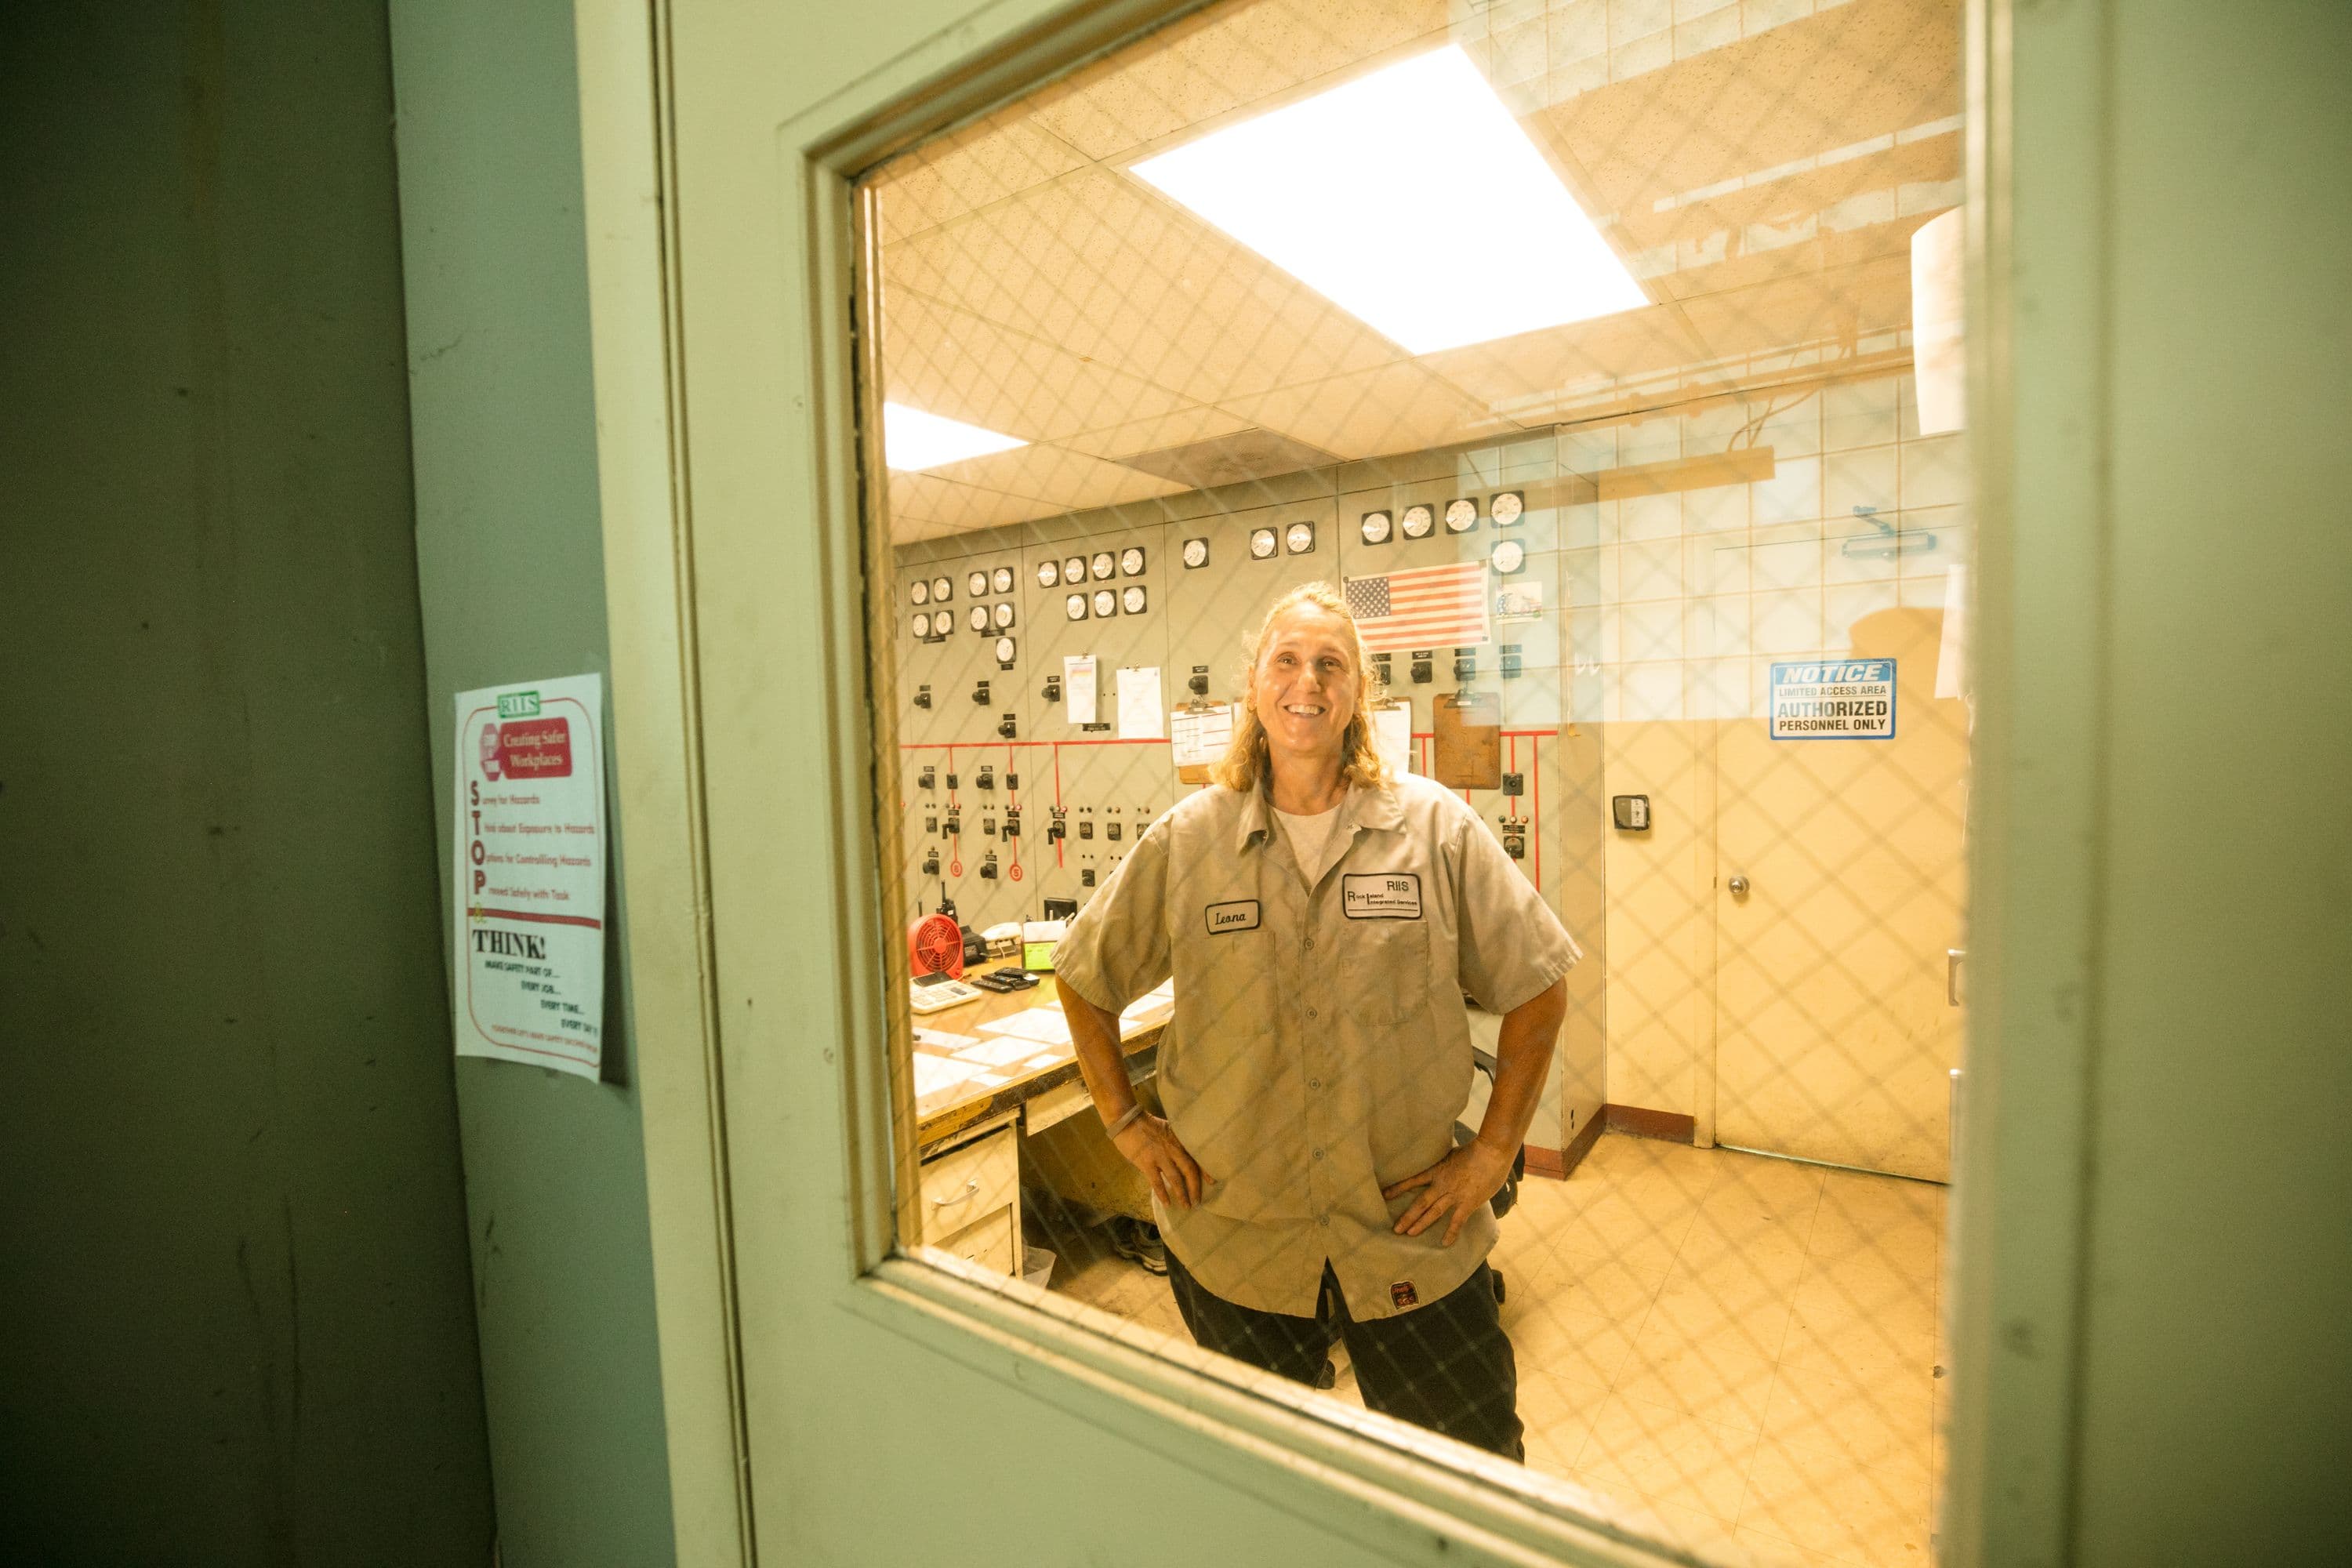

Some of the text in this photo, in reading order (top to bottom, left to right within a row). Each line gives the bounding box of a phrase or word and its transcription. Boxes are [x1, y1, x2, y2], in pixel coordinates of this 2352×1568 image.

[1783, 664, 1882, 684] NOTICE
[1779, 685, 1886, 697] LIMITED ACCESS AREA
[1777, 700, 1888, 718] AUTHORIZED
[1779, 719, 1886, 731] PERSONNEL ONLY
[503, 730, 566, 750] Creating Safer
[510, 753, 563, 771] Workplaces
[1386, 880, 1409, 891] RIIS
[1347, 891, 1366, 902] Rock
[1214, 913, 1247, 925] Leona
[472, 929, 546, 960] THINK!
